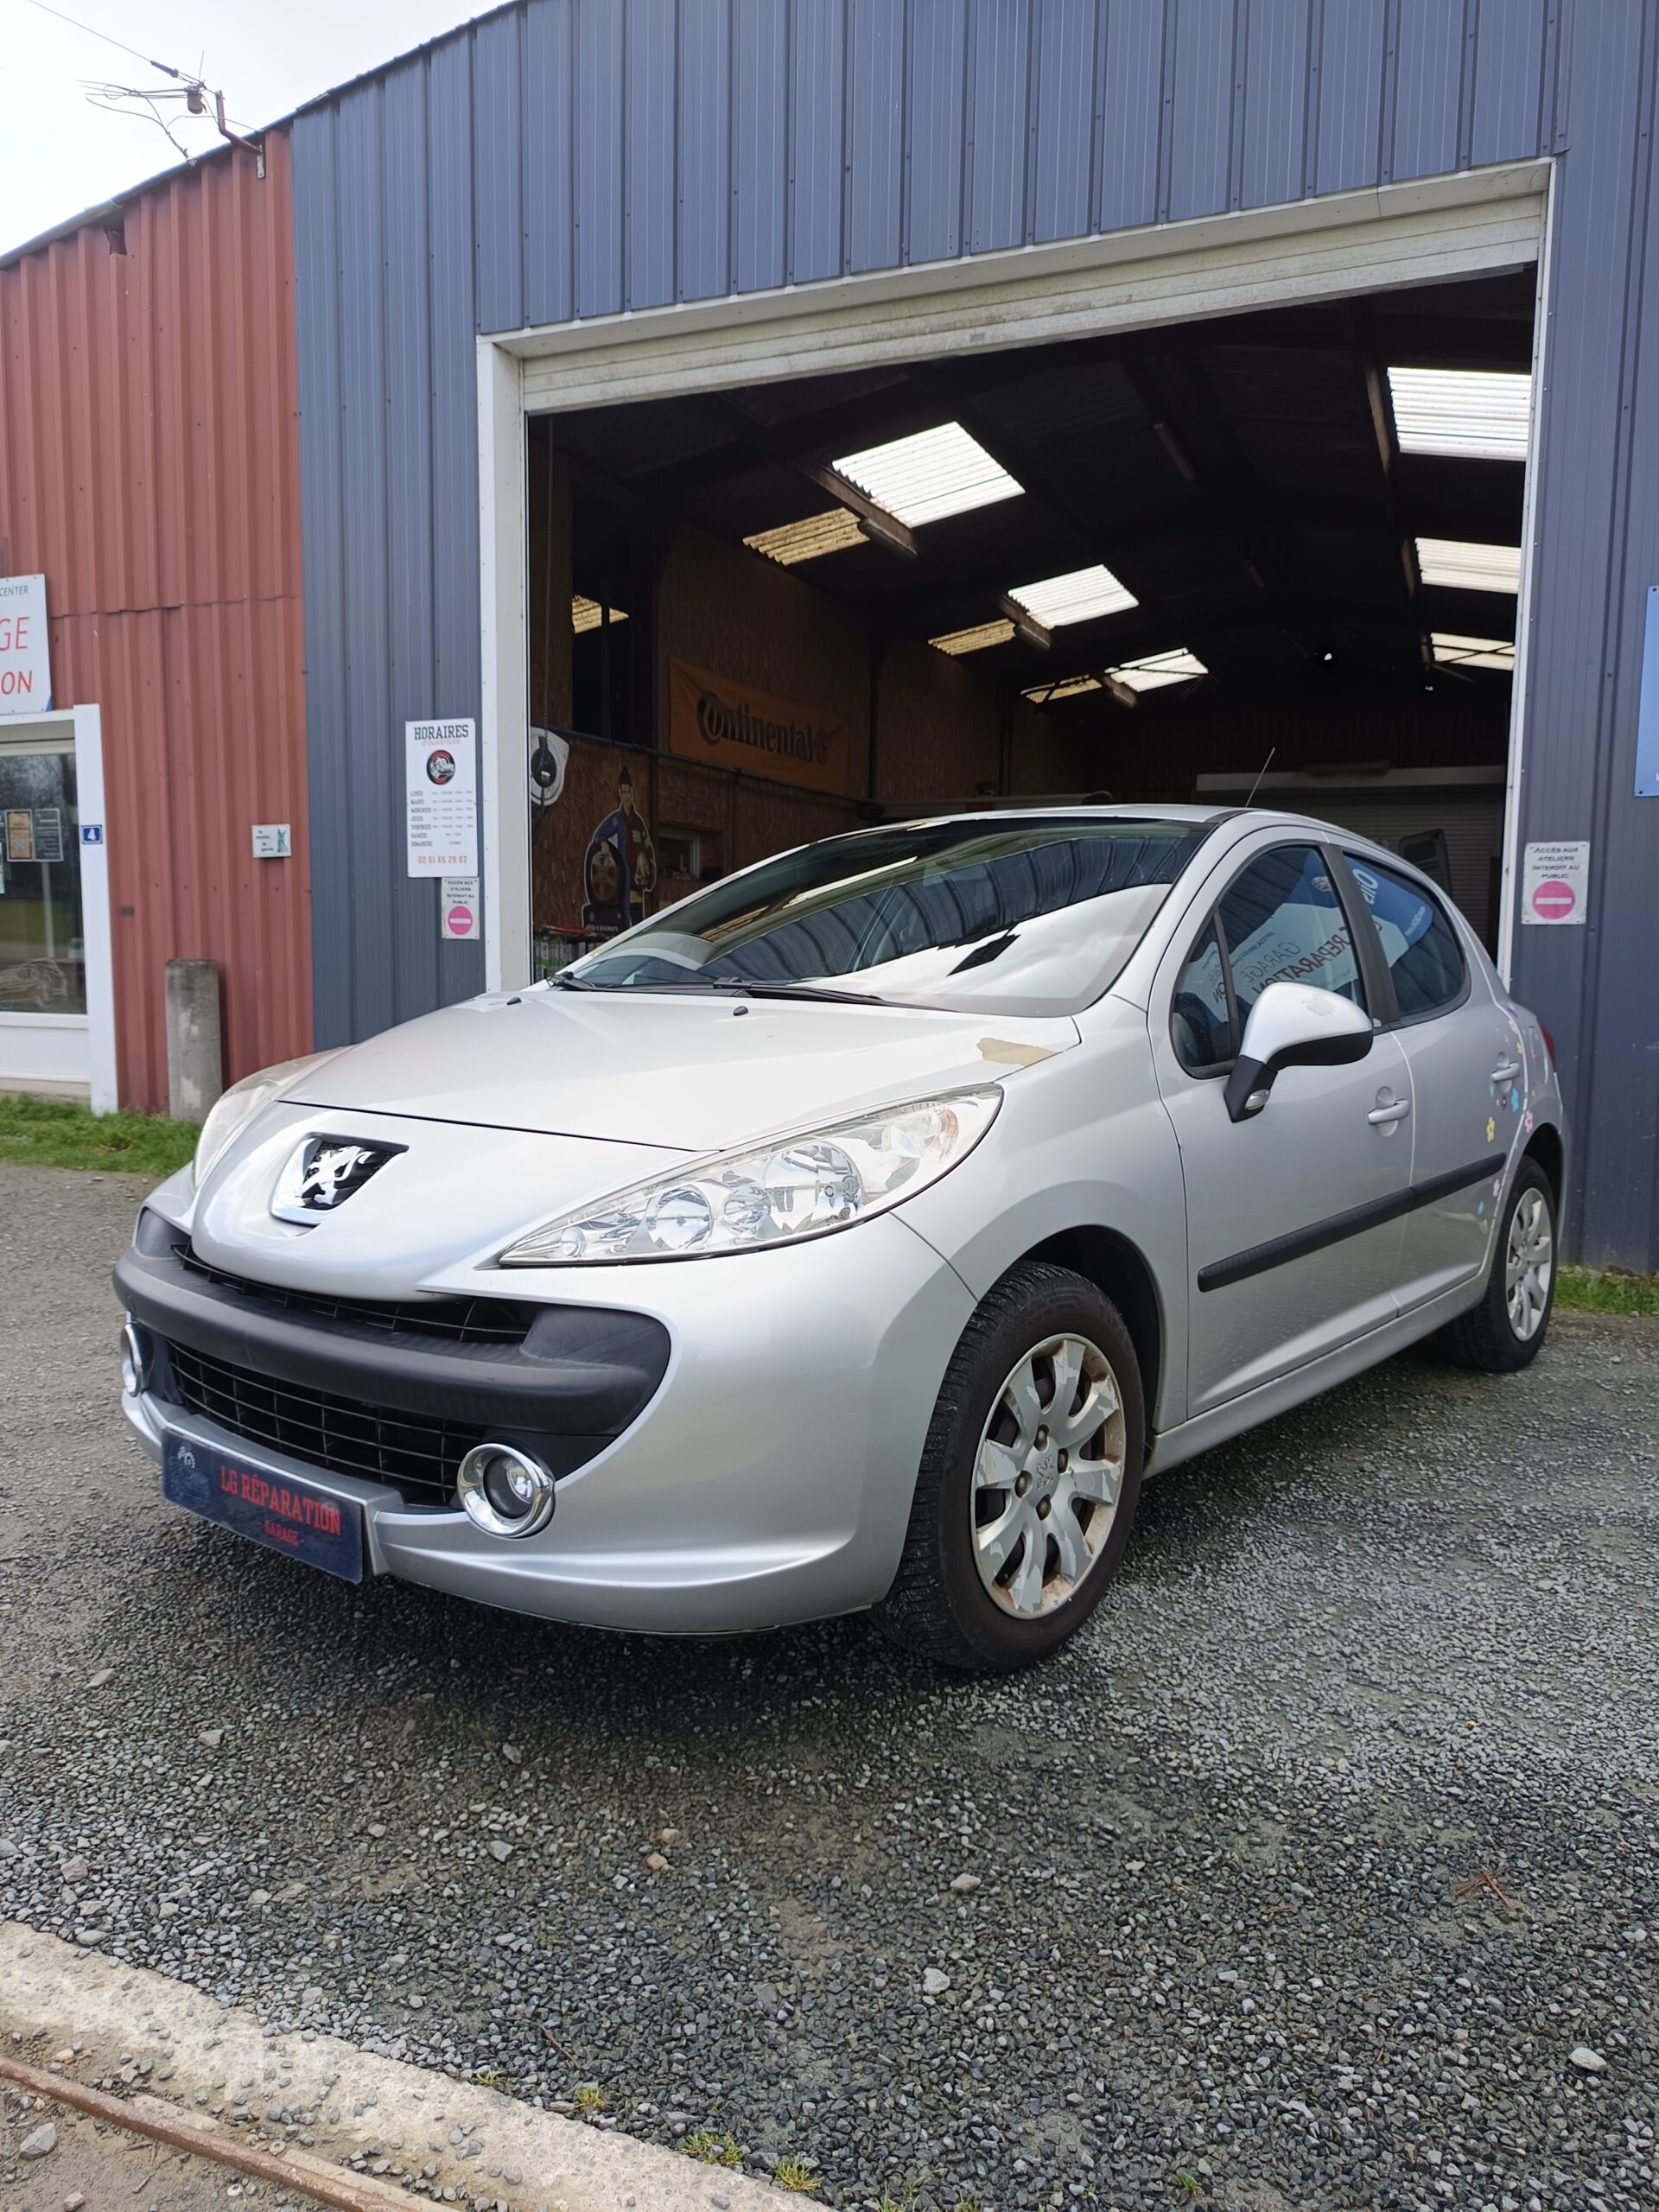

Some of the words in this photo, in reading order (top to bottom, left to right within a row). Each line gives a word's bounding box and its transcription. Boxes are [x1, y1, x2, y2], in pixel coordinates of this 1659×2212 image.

[414, 724, 469, 740] HORAIRES
[696, 690, 812, 762] Continental
[220, 1465, 238, 1495] LG
[241, 1472, 341, 1536] RÉPARATION
